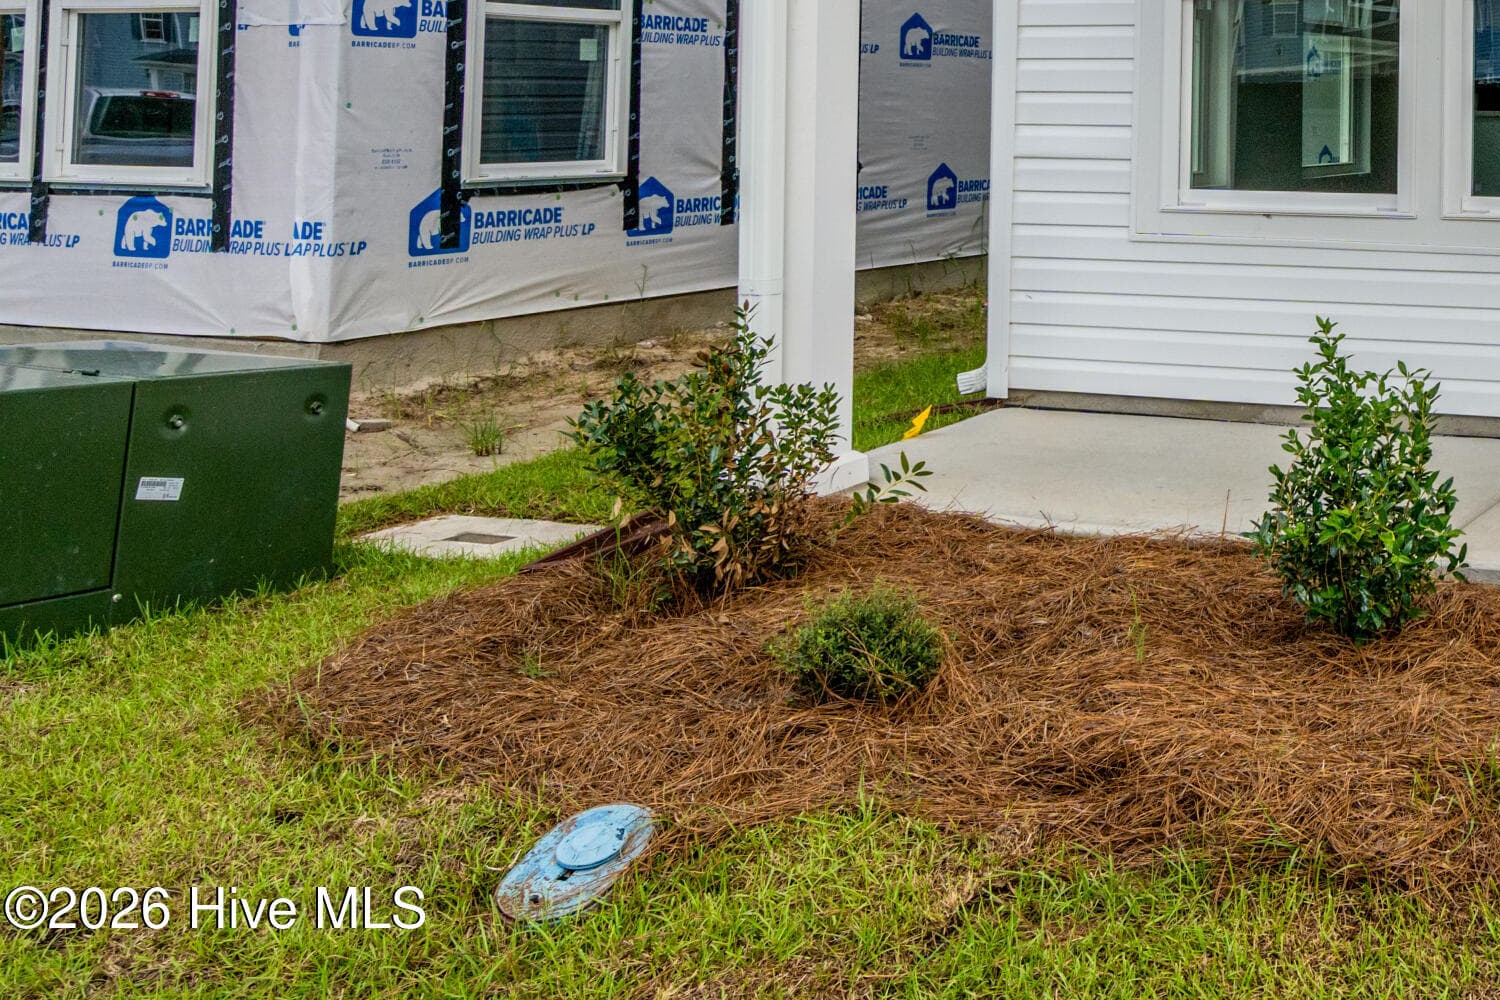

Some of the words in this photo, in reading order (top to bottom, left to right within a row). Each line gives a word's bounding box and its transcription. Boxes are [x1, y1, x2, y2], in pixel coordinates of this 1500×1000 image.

[676, 33, 699, 45] WRAP
[700, 35, 720, 46] PLUS
[932, 32, 980, 48] BARRICADE
[870, 44, 879, 54] LP
[898, 199, 907, 208] LP
[473, 207, 563, 229] BARRICADE
[674, 214, 712, 227] BUILDING
[472, 228, 521, 245] BUILDING
[523, 226, 552, 240] WRAP
[553, 224, 578, 237] PLUS
[581, 223, 595, 236] LP
[65, 235, 80, 248] LP
[349, 241, 367, 255] LP
[253, 242, 280, 256] PLUS
